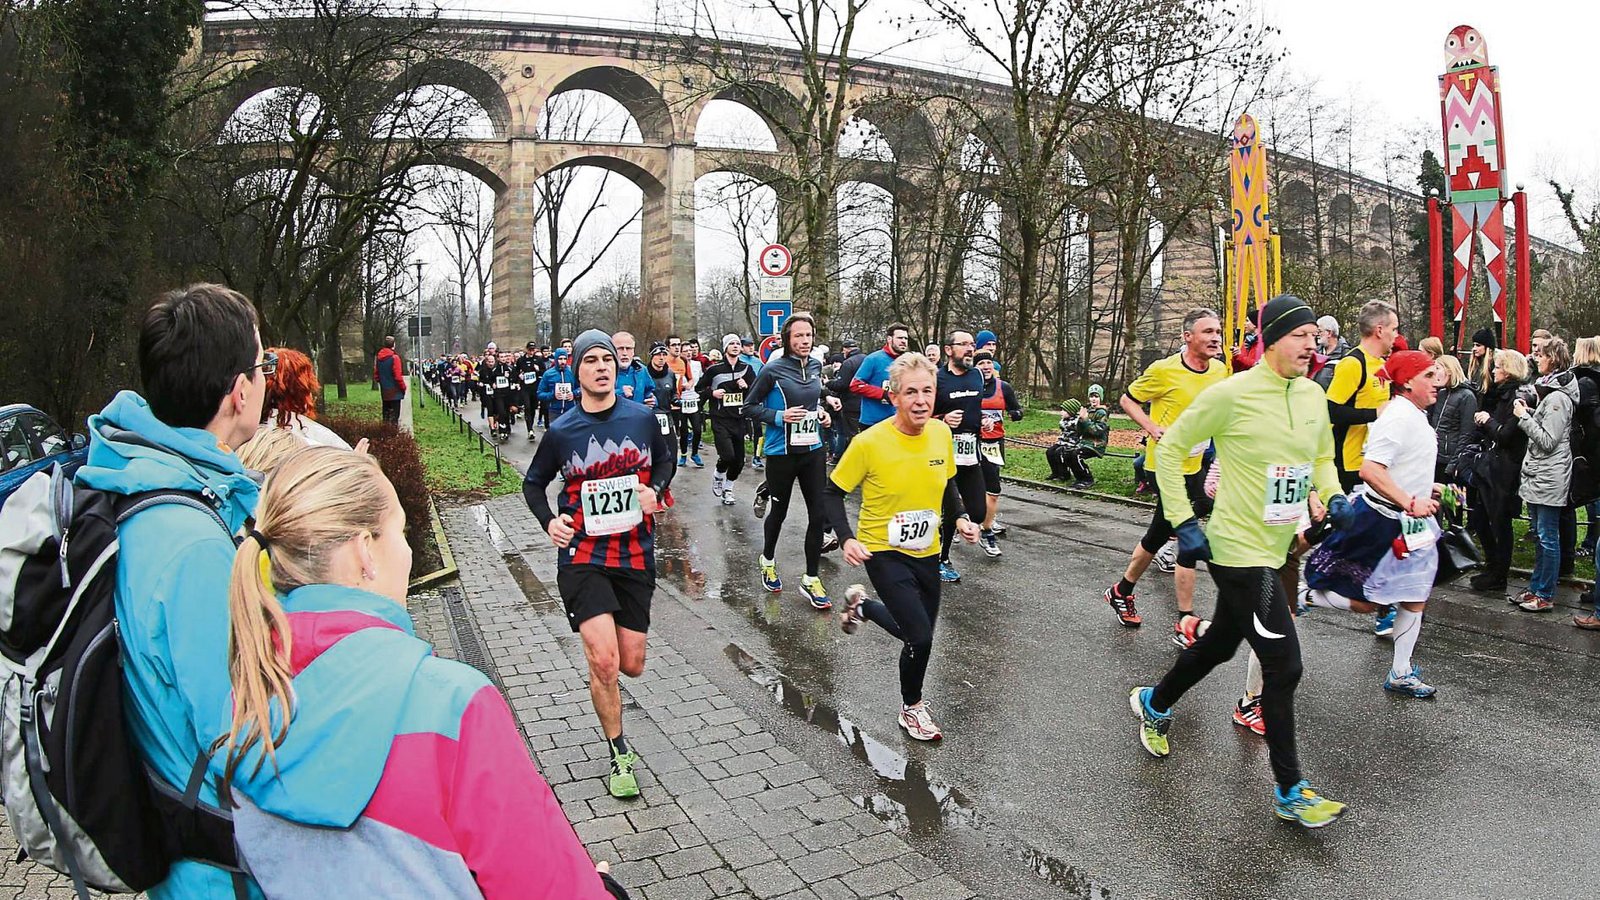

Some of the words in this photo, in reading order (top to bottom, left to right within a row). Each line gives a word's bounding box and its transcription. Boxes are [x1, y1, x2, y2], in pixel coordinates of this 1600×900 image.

[726, 394, 742, 403] 2142
[588, 488, 633, 516] 1237
[900, 520, 929, 542] 530
